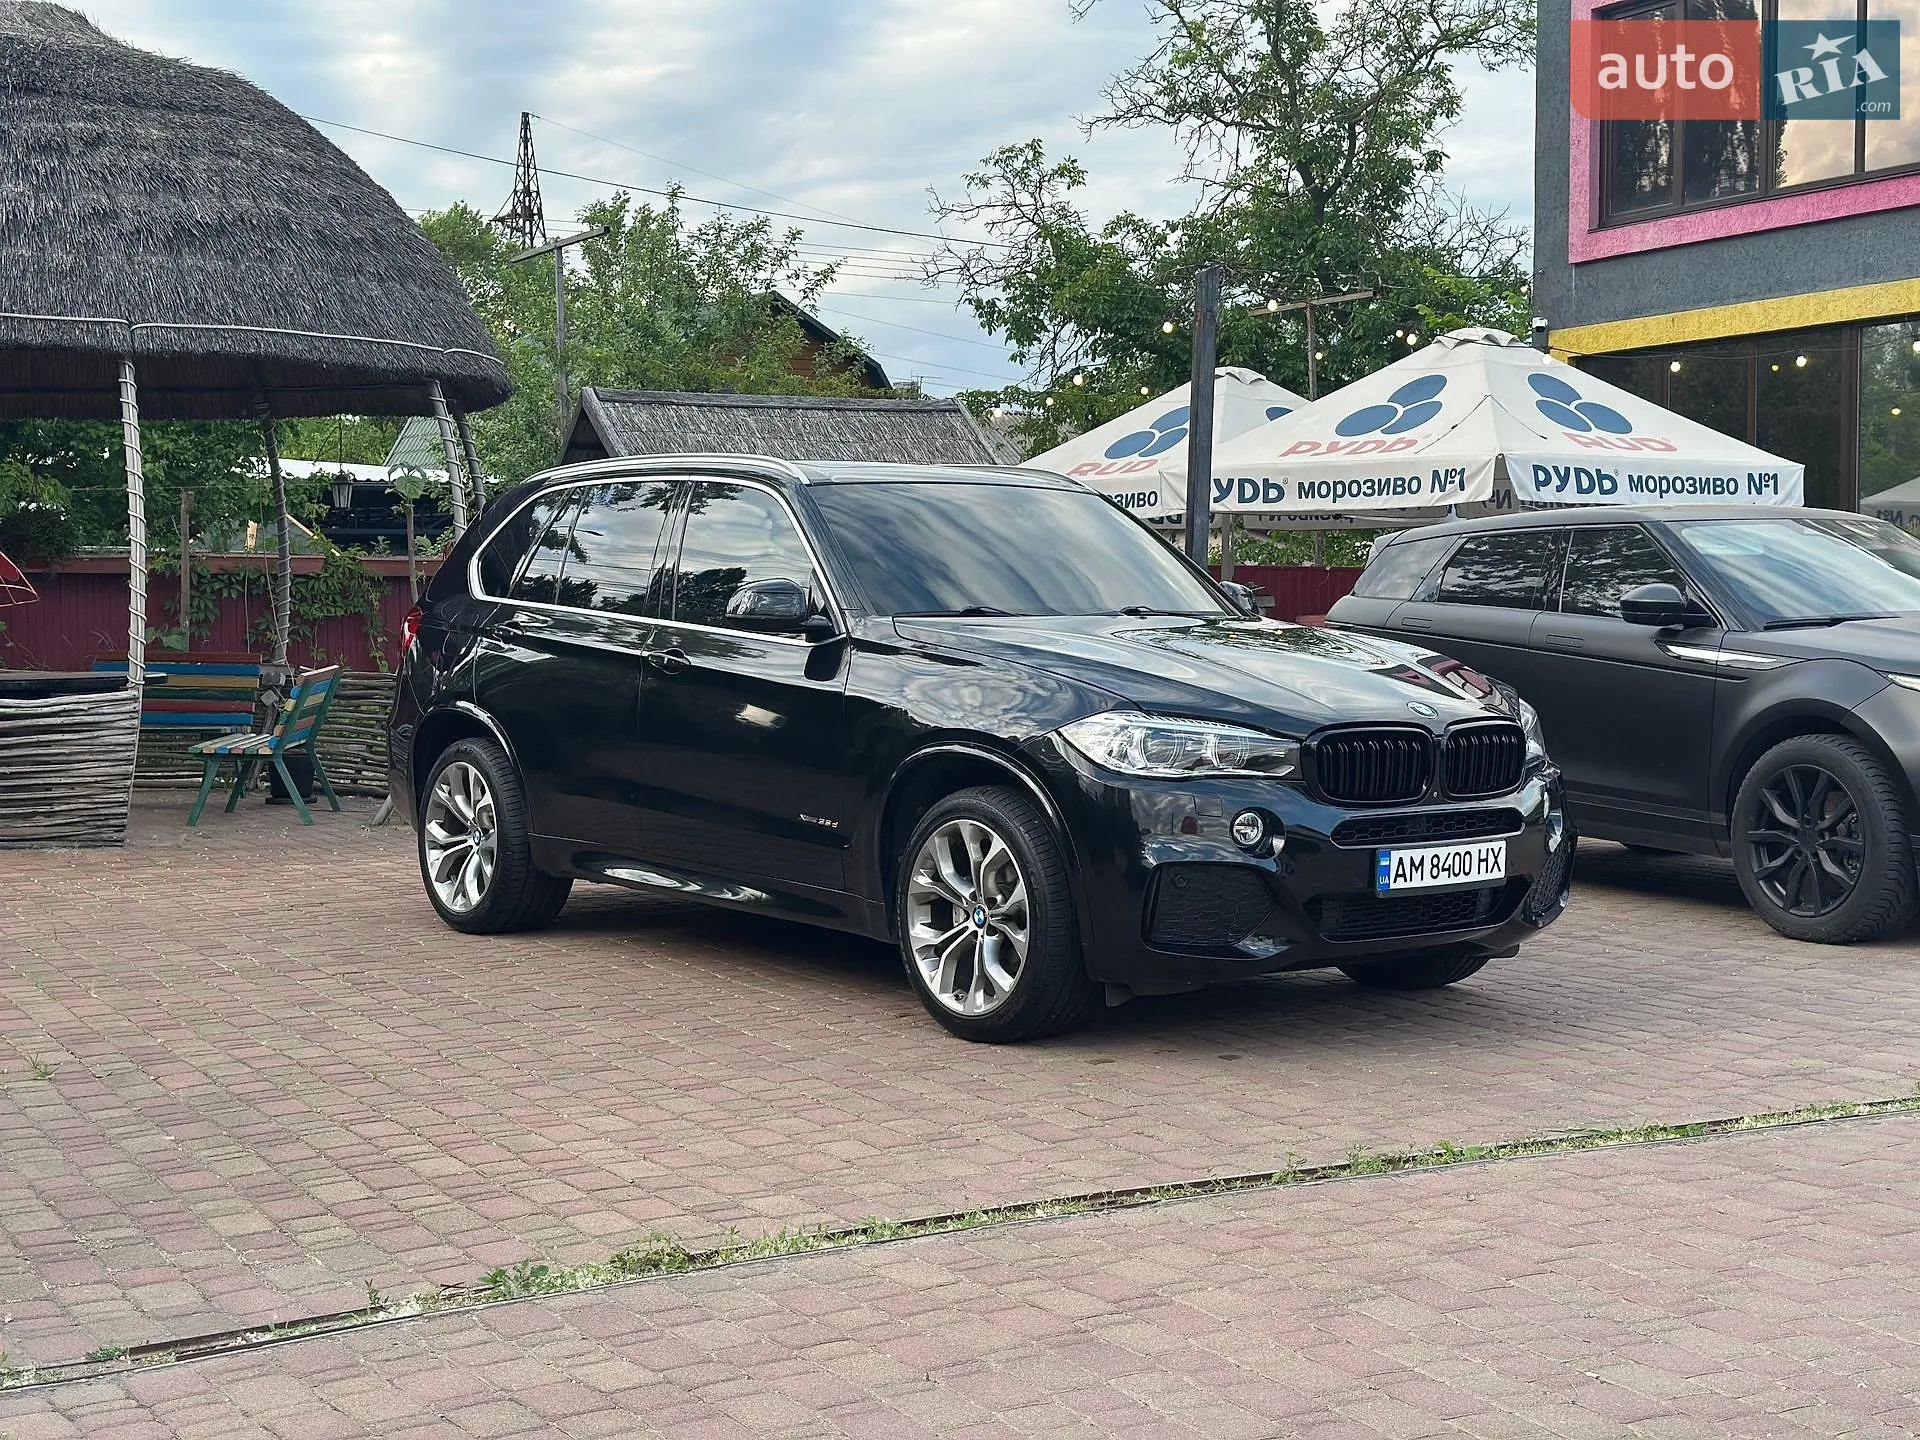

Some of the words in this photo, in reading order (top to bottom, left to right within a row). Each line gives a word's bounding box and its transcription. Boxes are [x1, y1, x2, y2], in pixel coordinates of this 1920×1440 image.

[1560, 431, 1678, 452] RUD
[1066, 458, 1159, 476] RUD
[1297, 475, 1422, 503] морозиво
[1430, 467, 1466, 494] №1
[1628, 474, 1739, 499] морозиво
[1747, 472, 1779, 496] №1
[1393, 854, 1425, 884] AM
[1430, 850, 1473, 880] 8400
[1478, 846, 1503, 875] HX
[1379, 875, 1390, 885] UA
